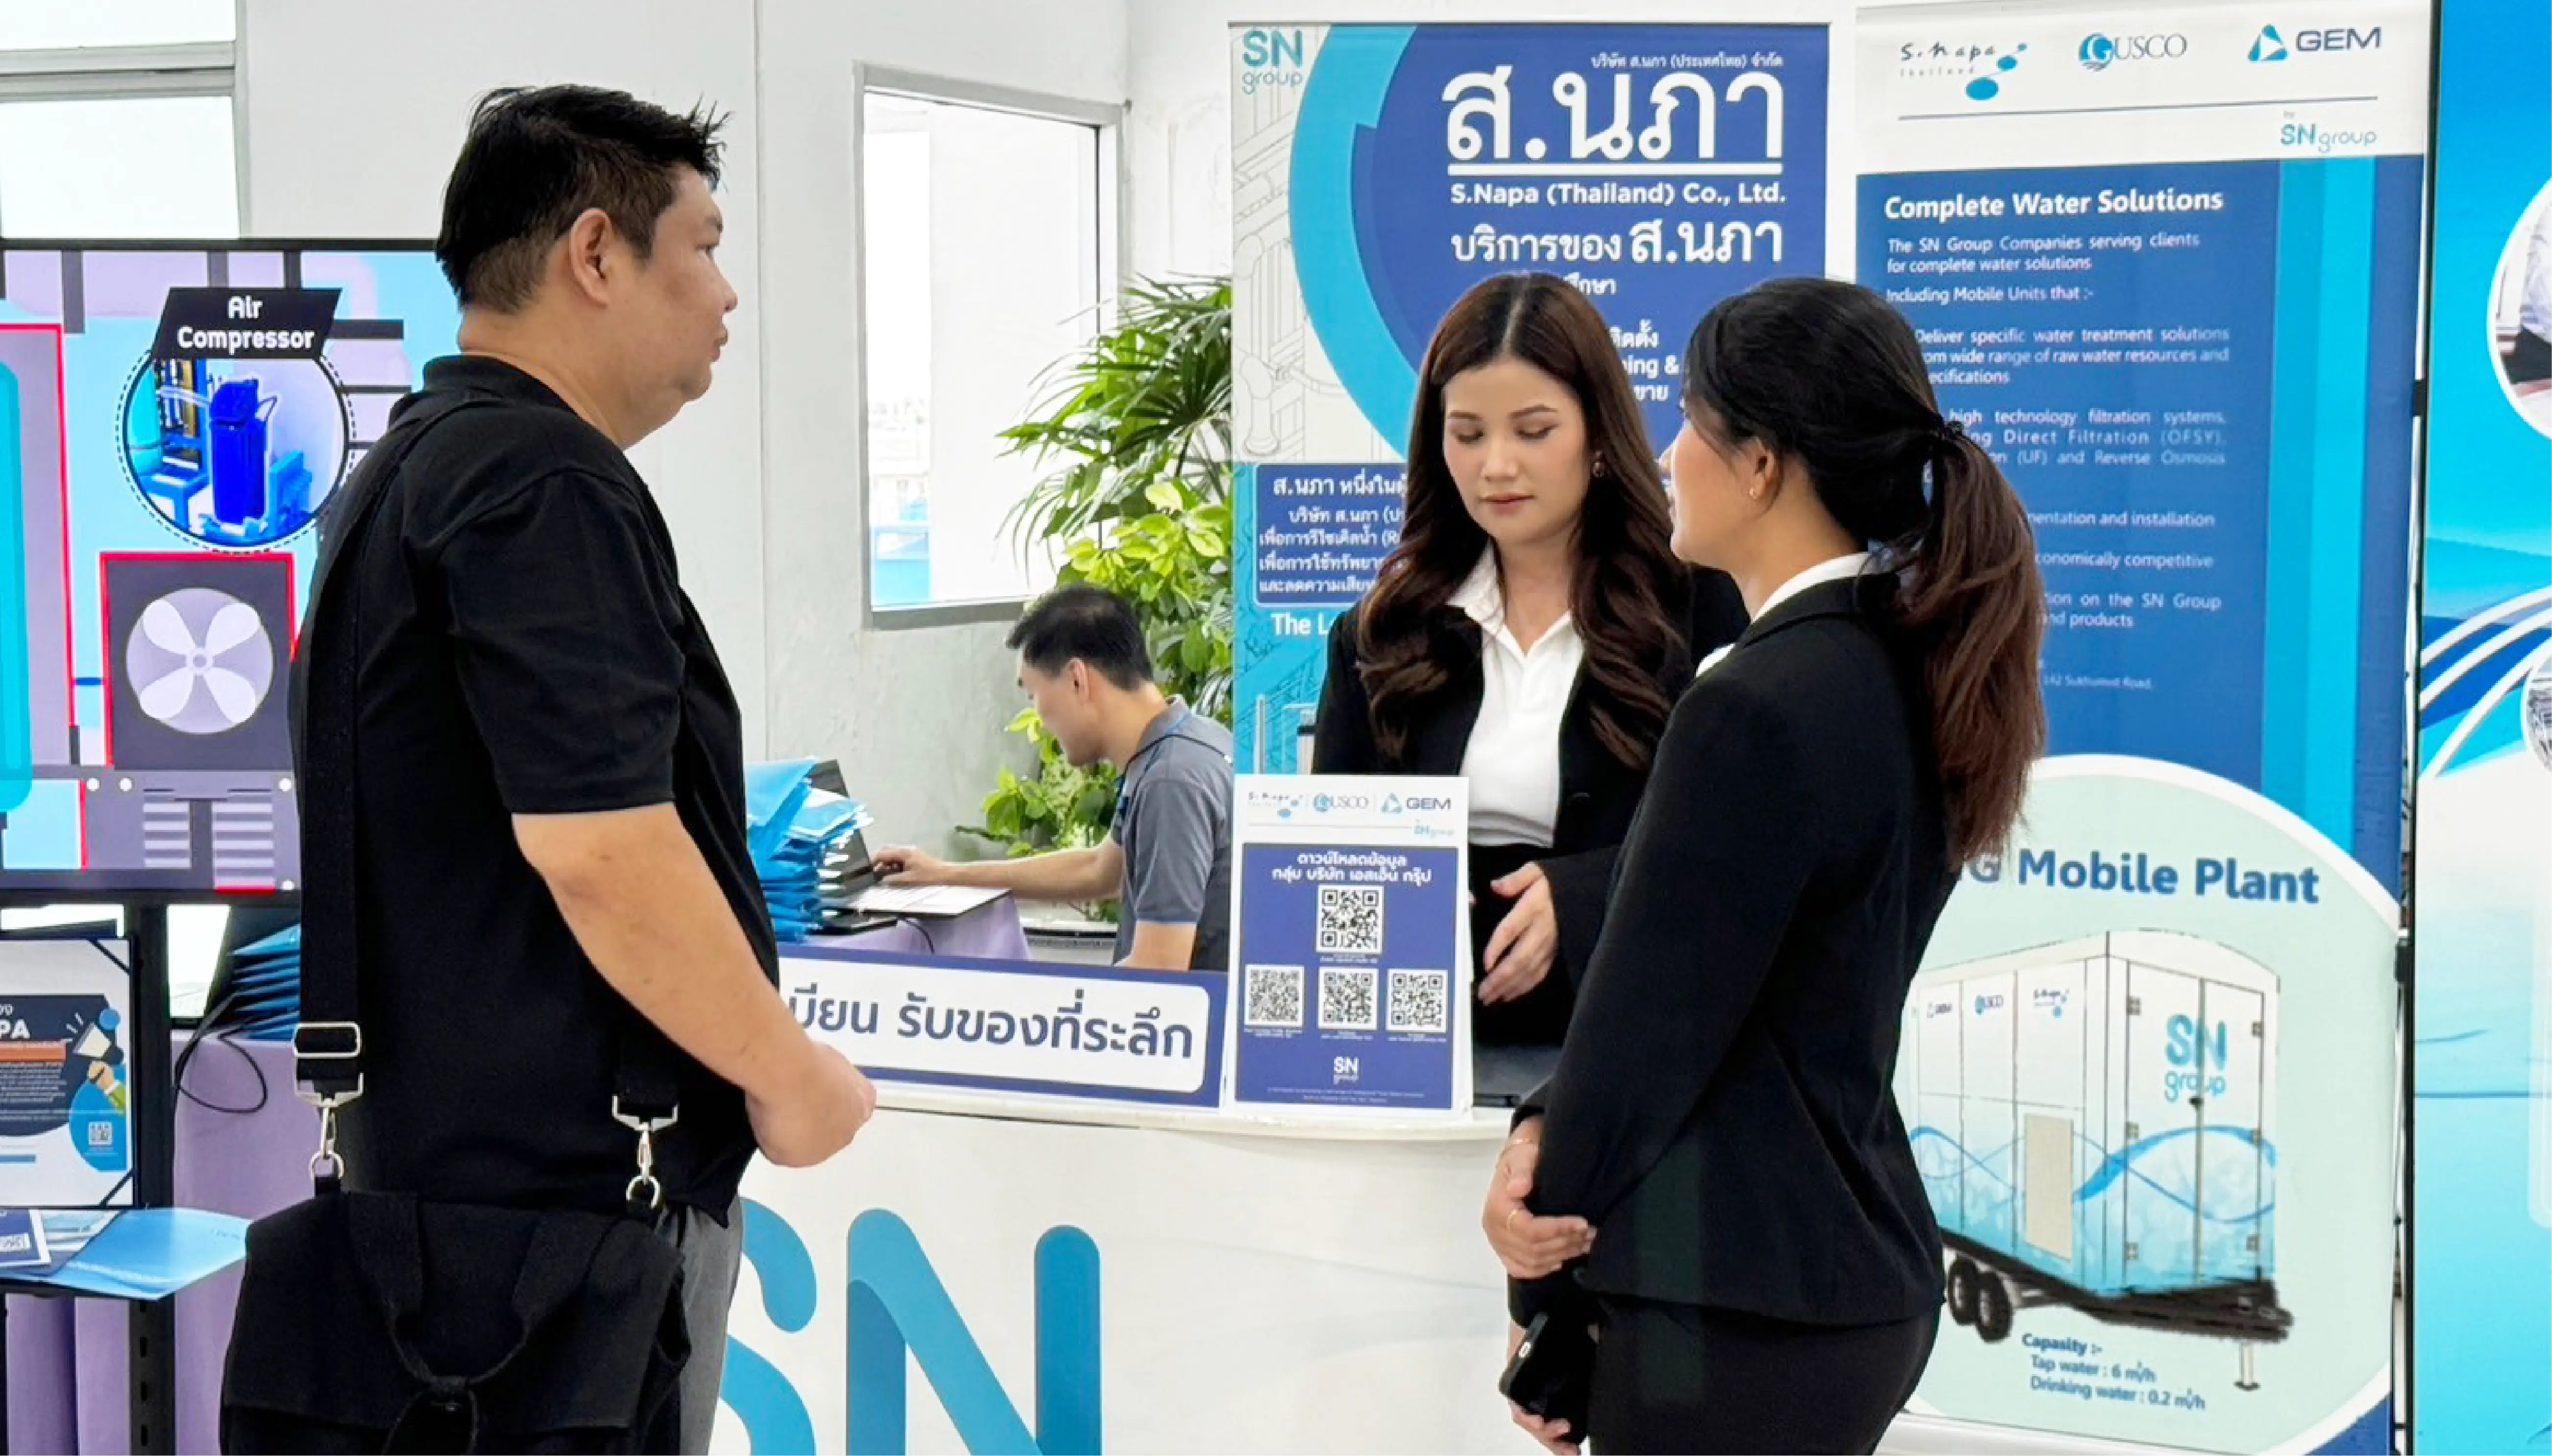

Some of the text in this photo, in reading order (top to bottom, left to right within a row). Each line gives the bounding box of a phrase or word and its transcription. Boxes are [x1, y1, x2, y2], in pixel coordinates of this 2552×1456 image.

[1242, 30, 1303, 68] SN
[2296, 26, 2382, 52] GEM
[1242, 72, 1303, 95] group
[1441, 65, 1784, 160] ส.นภา
[2281, 123, 2378, 153] SN group
[1451, 182, 1786, 207] S.Napa (Thailand) Co., Ltd.
[1885, 189, 2224, 223] Complete Water Solutions
[1450, 218, 1783, 264] บริการของ ส.นภา
[1888, 232, 2200, 254] The SN Group Companies serving clients
[1887, 255, 2092, 276] for complete water solutions
[1886, 287, 1949, 306] Including
[1953, 286, 2004, 302] Mobile
[2008, 286, 2047, 301] Units
[2050, 286, 2080, 300] that
[227, 295, 264, 320] Air
[177, 325, 316, 356] Compressor
[1971, 328, 2025, 347] specific
[2033, 328, 2075, 343] water
[2081, 327, 2153, 343] treatment
[2161, 325, 2230, 342] solutions
[1664, 355, 1680, 375] &
[1950, 348, 1985, 364] wide
[1989, 350, 2030, 367] range
[2035, 347, 2050, 363] of
[2053, 350, 2079, 363] raw
[2082, 349, 2122, 363] water
[2125, 349, 2197, 363] resources
[2200, 347, 2230, 362] and
[1994, 408, 2078, 427] technology
[2088, 407, 2151, 424] filtration
[2004, 428, 2057, 444] Direct
[2068, 429, 2150, 445] Filtration
[2057, 449, 2086, 465] and
[2095, 449, 2151, 465] Reverse
[1273, 477, 1335, 495] ส.นภา
[2099, 510, 2128, 527] and
[2132, 510, 2215, 528] installation
[2124, 552, 2214, 570] competitive
[2080, 594, 2100, 607] on
[2109, 593, 2134, 607] the
[2141, 593, 2164, 608] SN
[2173, 593, 2222, 612] Group
[1271, 612, 1312, 636] The
[2069, 612, 2135, 630] products
[1406, 797, 1452, 811] GEM
[2018, 849, 2179, 895] Mobile
[2195, 857, 2320, 904] Plant
[896, 989, 1193, 1060] รับของที่ระลึก
[2166, 1014, 2227, 1070] SN
[2164, 1071, 2227, 1103] group
[2031, 1354, 2056, 1373] Tap
[2060, 1360, 2100, 1376] water
[2030, 1374, 2092, 1401] Drinking
[2095, 1385, 2137, 1402] water
[2147, 1387, 2171, 1406] 0.2
